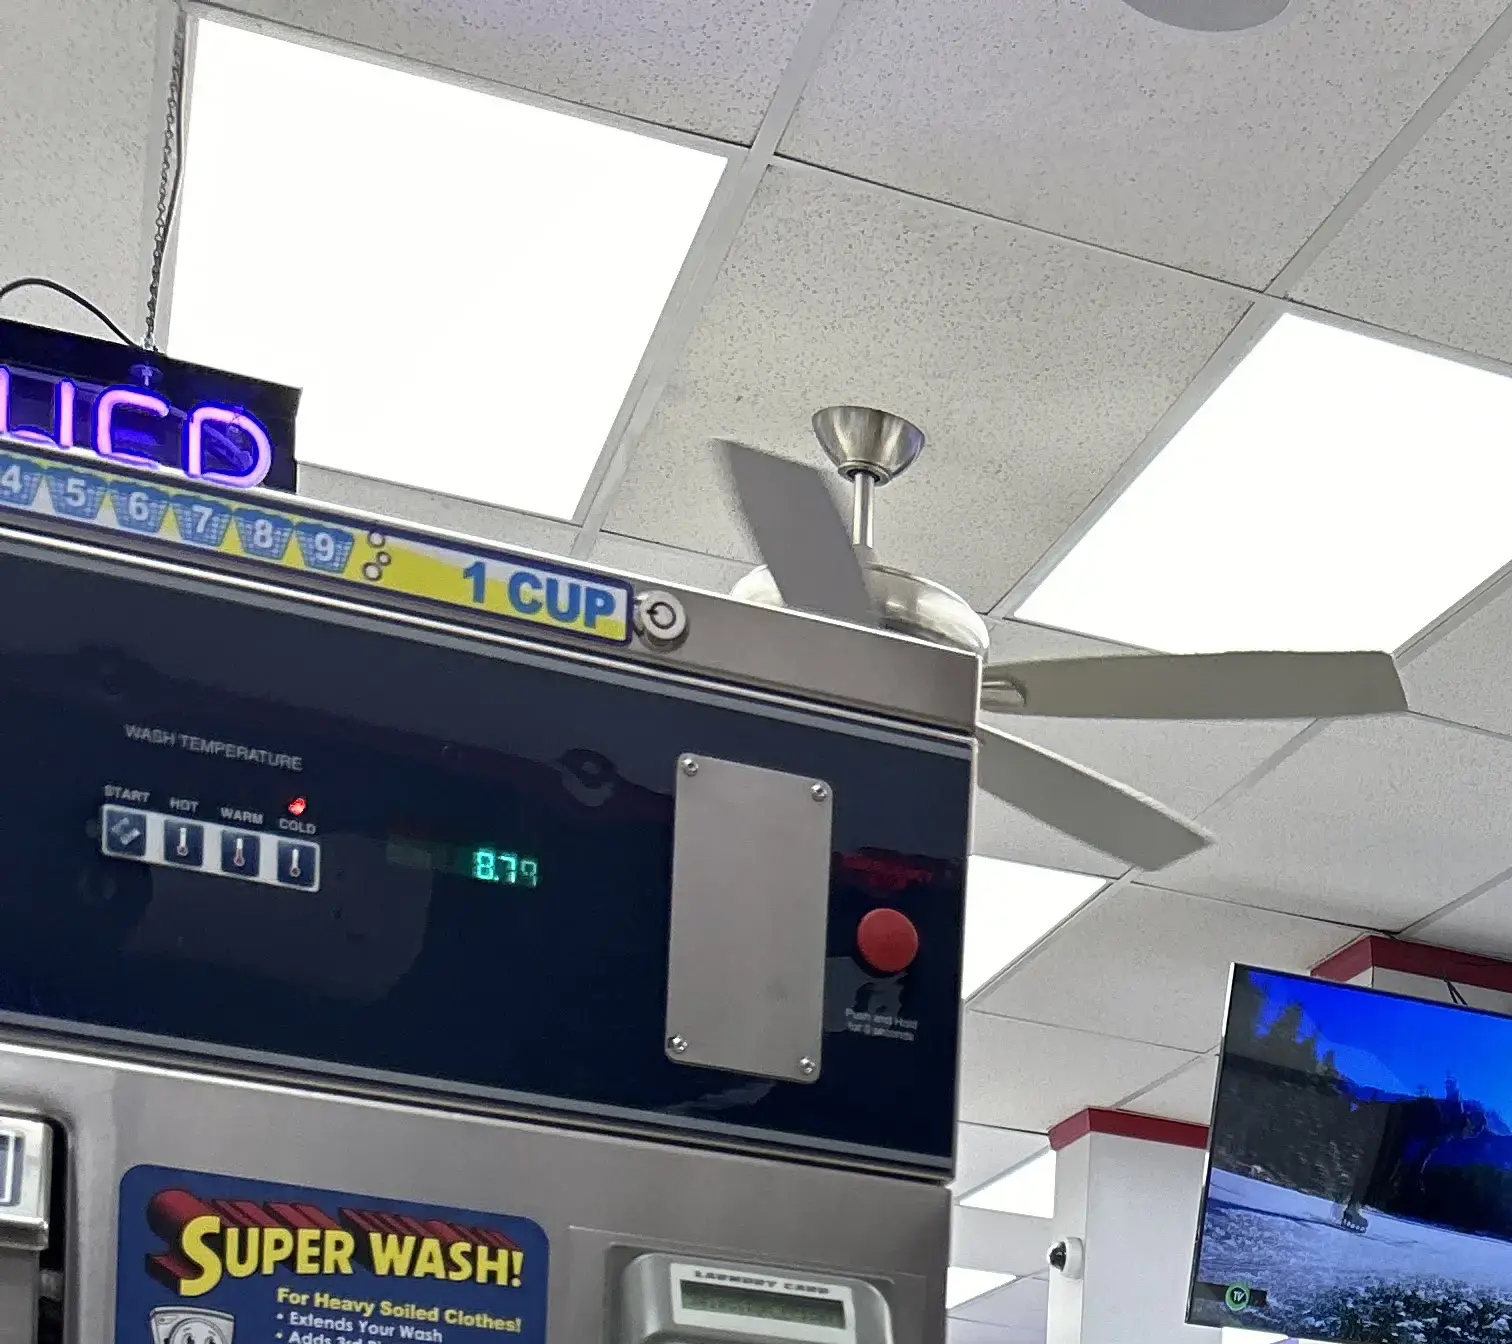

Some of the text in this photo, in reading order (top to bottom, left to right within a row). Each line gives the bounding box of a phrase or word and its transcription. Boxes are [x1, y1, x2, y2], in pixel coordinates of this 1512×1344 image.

[1, 464, 336, 562] 4 5 6 7 8 9
[463, 560, 617, 629] 1 CUP
[123, 723, 304, 772] WASH TEMPERATURE
[104, 784, 151, 803] START
[169, 796, 200, 813] HOT
[219, 806, 265, 826] WARM
[278, 817, 318, 836] COLD
[474, 850, 538, 887] 8.79
[178, 1214, 525, 1298] SUPER WASH!
[694, 1269, 830, 1295] LAUNDRY CARD
[1233, 1290, 1245, 1302] TV
[276, 1287, 522, 1334] For Heavy Soiled Clothes!
[289, 1311, 443, 1344] Extends Your Wash
